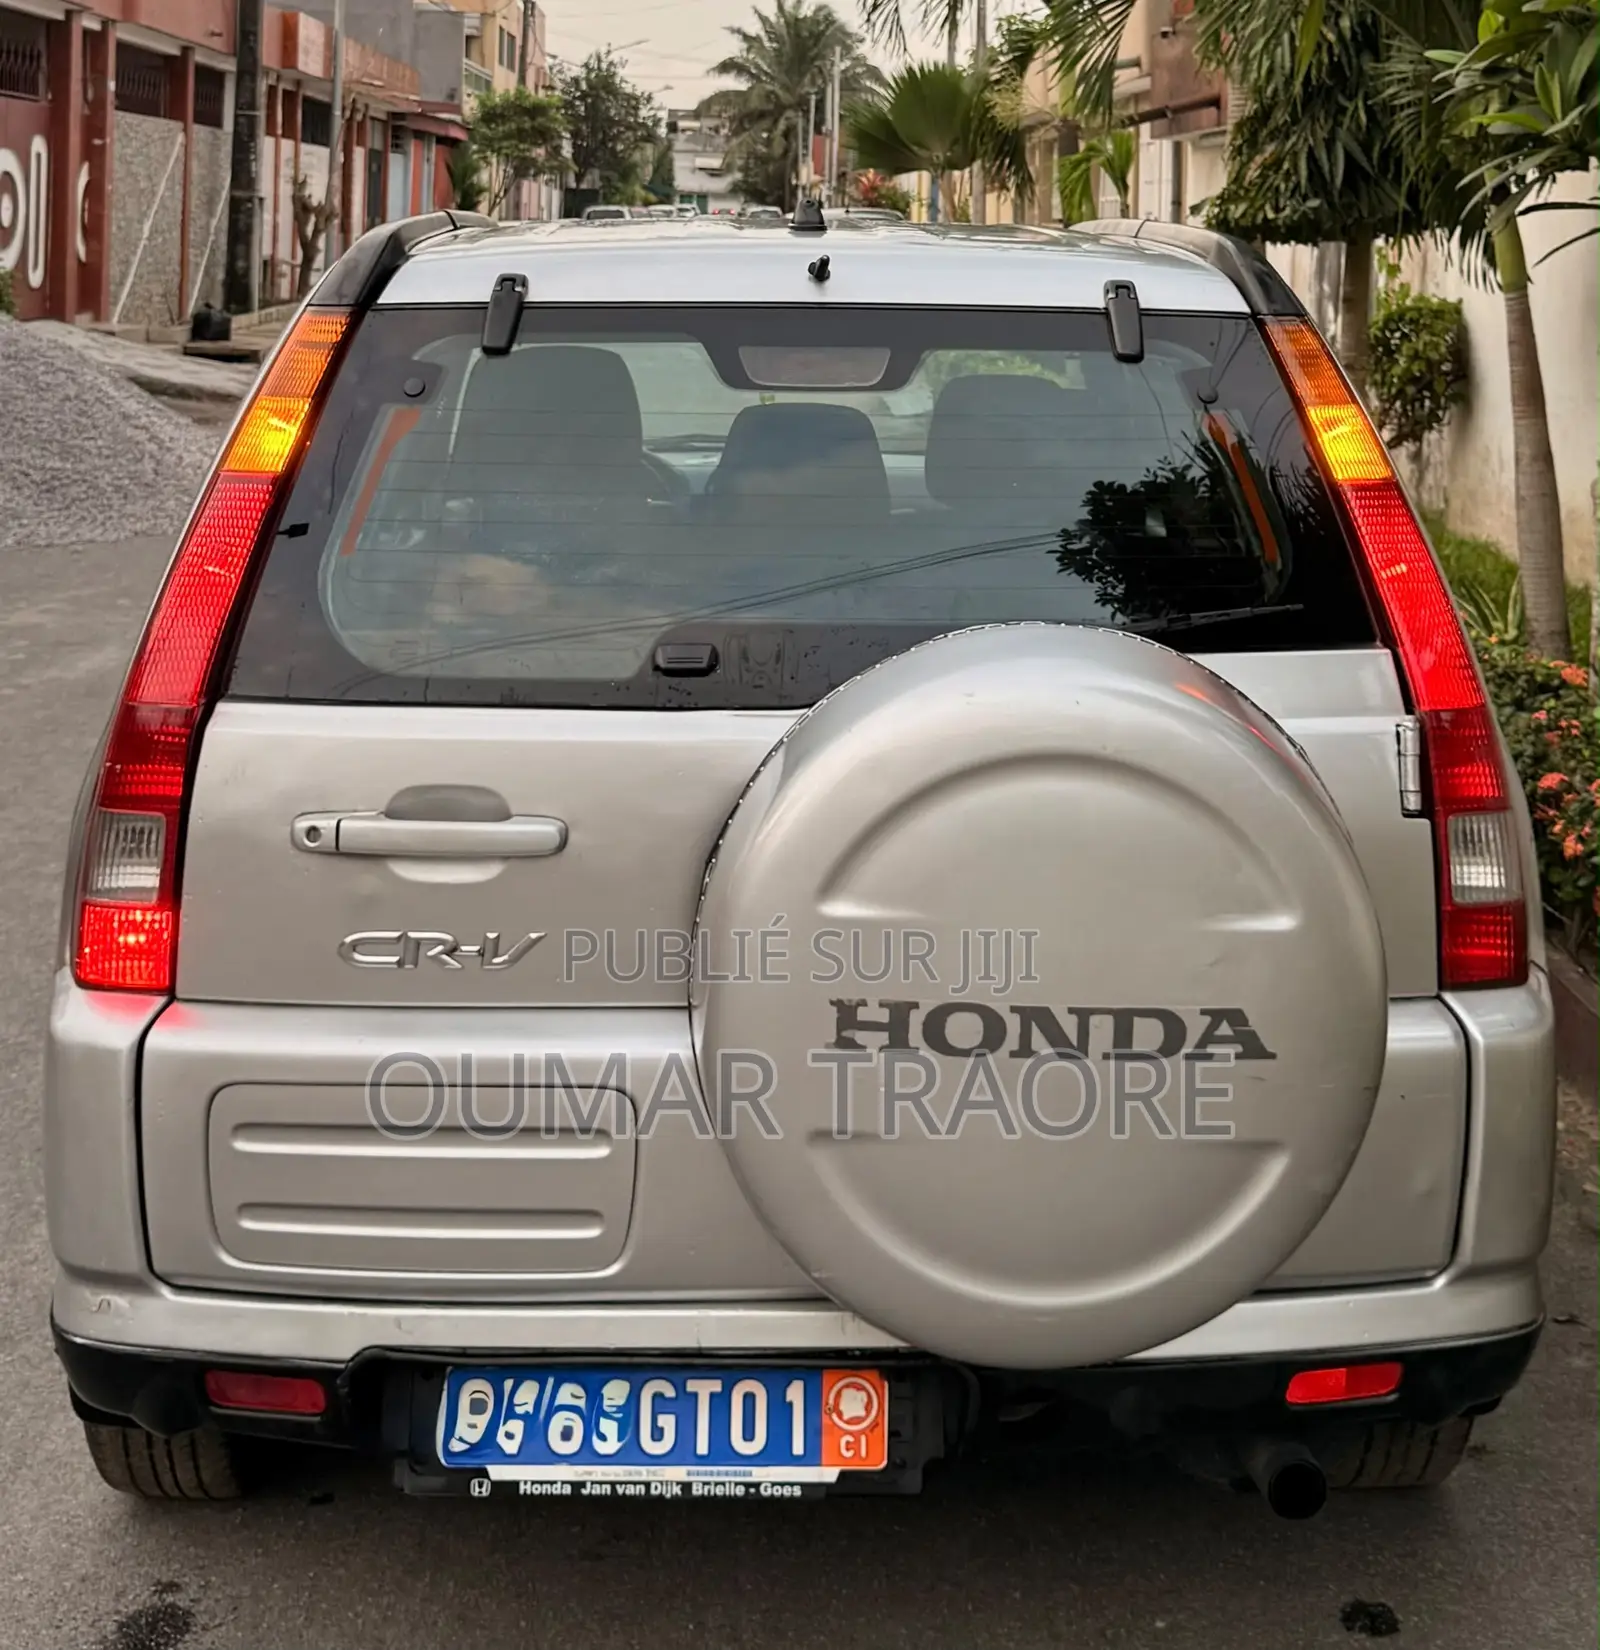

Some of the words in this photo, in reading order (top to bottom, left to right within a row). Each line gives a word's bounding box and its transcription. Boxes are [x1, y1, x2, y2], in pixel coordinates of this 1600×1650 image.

[337, 930, 547, 970] CR-V
[828, 998, 1277, 1060] HONDA
[840, 1434, 867, 1459] CI
[518, 1480, 572, 1496] Honda
[580, 1481, 611, 1496] Jan
[615, 1483, 646, 1496] van
[649, 1481, 682, 1499] Dijk
[691, 1481, 746, 1497] Brielle
[759, 1482, 802, 1497] Goes
